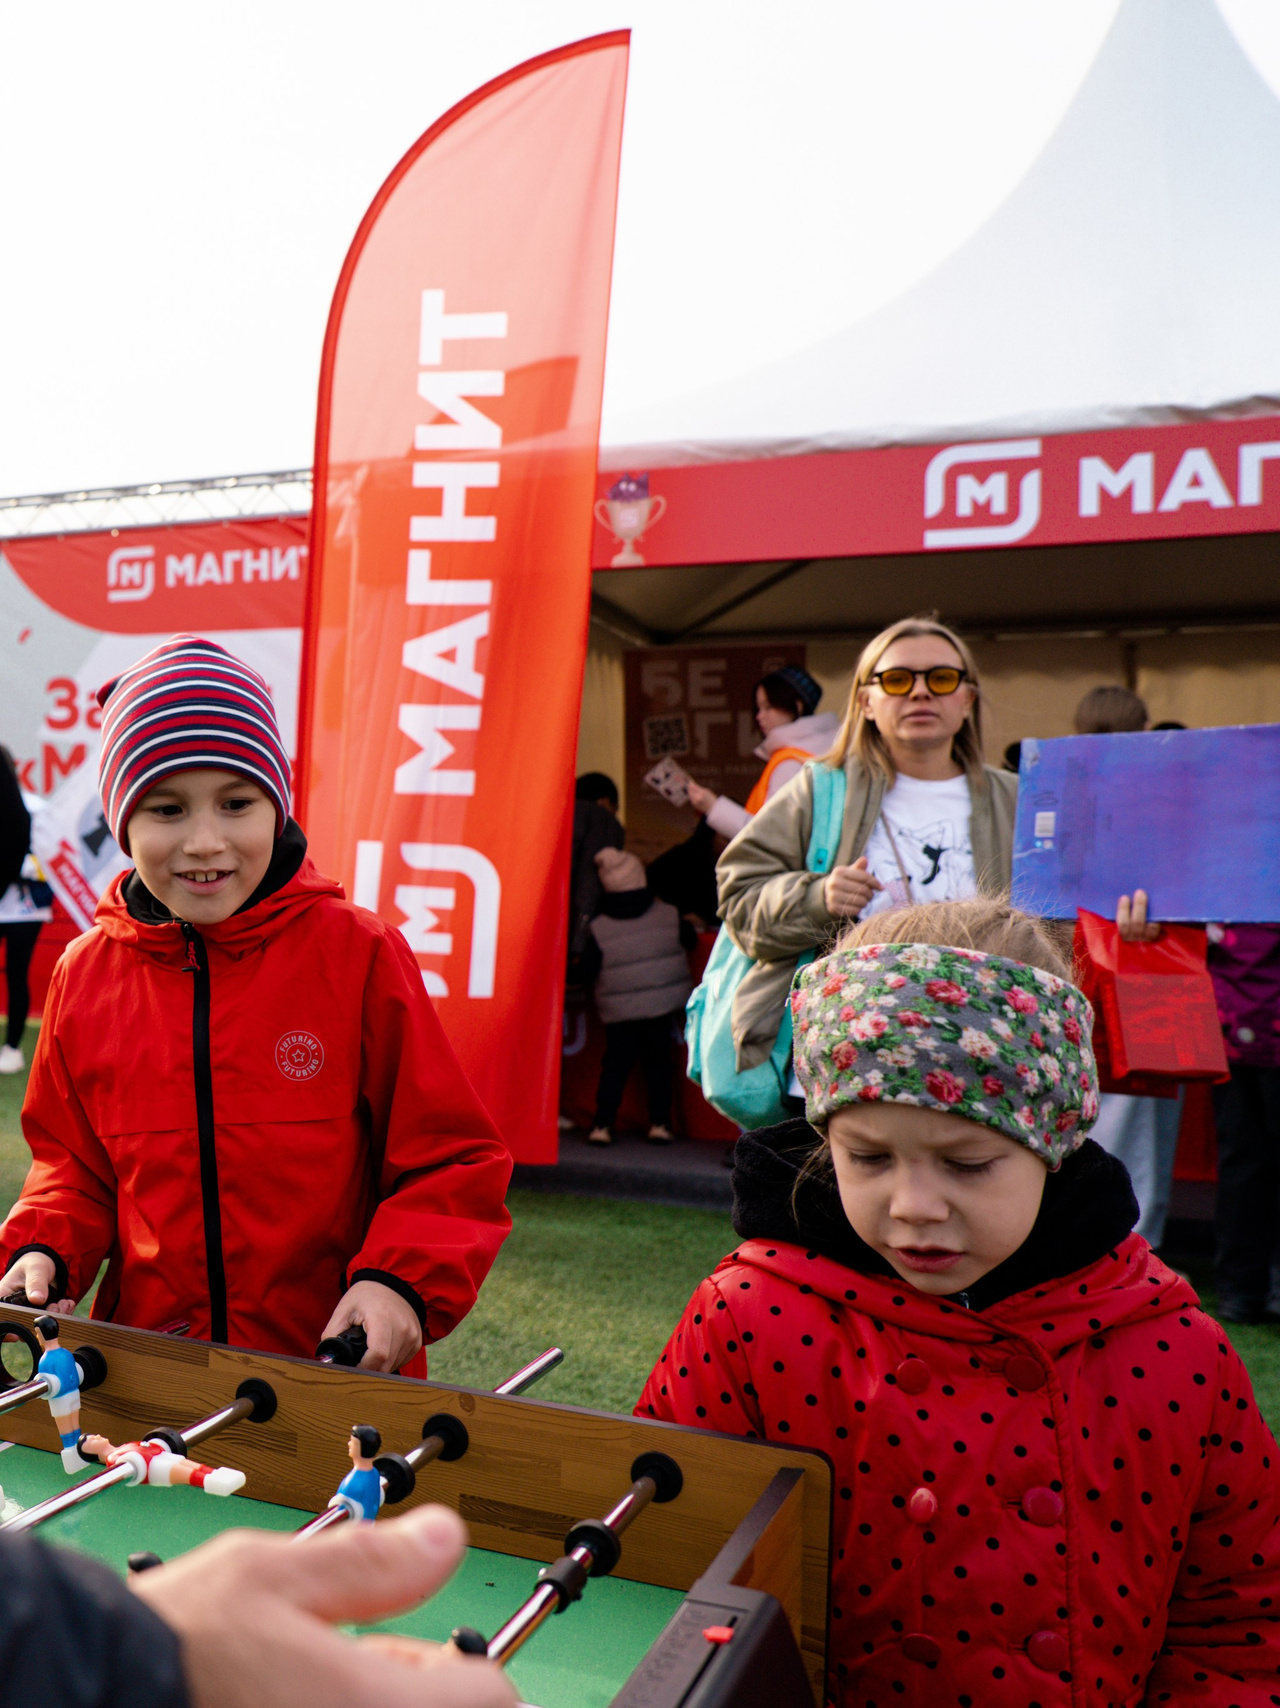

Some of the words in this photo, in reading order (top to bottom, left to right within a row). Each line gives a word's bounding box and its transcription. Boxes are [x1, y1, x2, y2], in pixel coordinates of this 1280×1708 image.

[393, 288, 508, 796] МАГНИТ
[165, 546, 308, 587] МАГНИ
[279, 1035, 318, 1052] FUTURINO
[281, 1058, 319, 1078] FUTURINO
